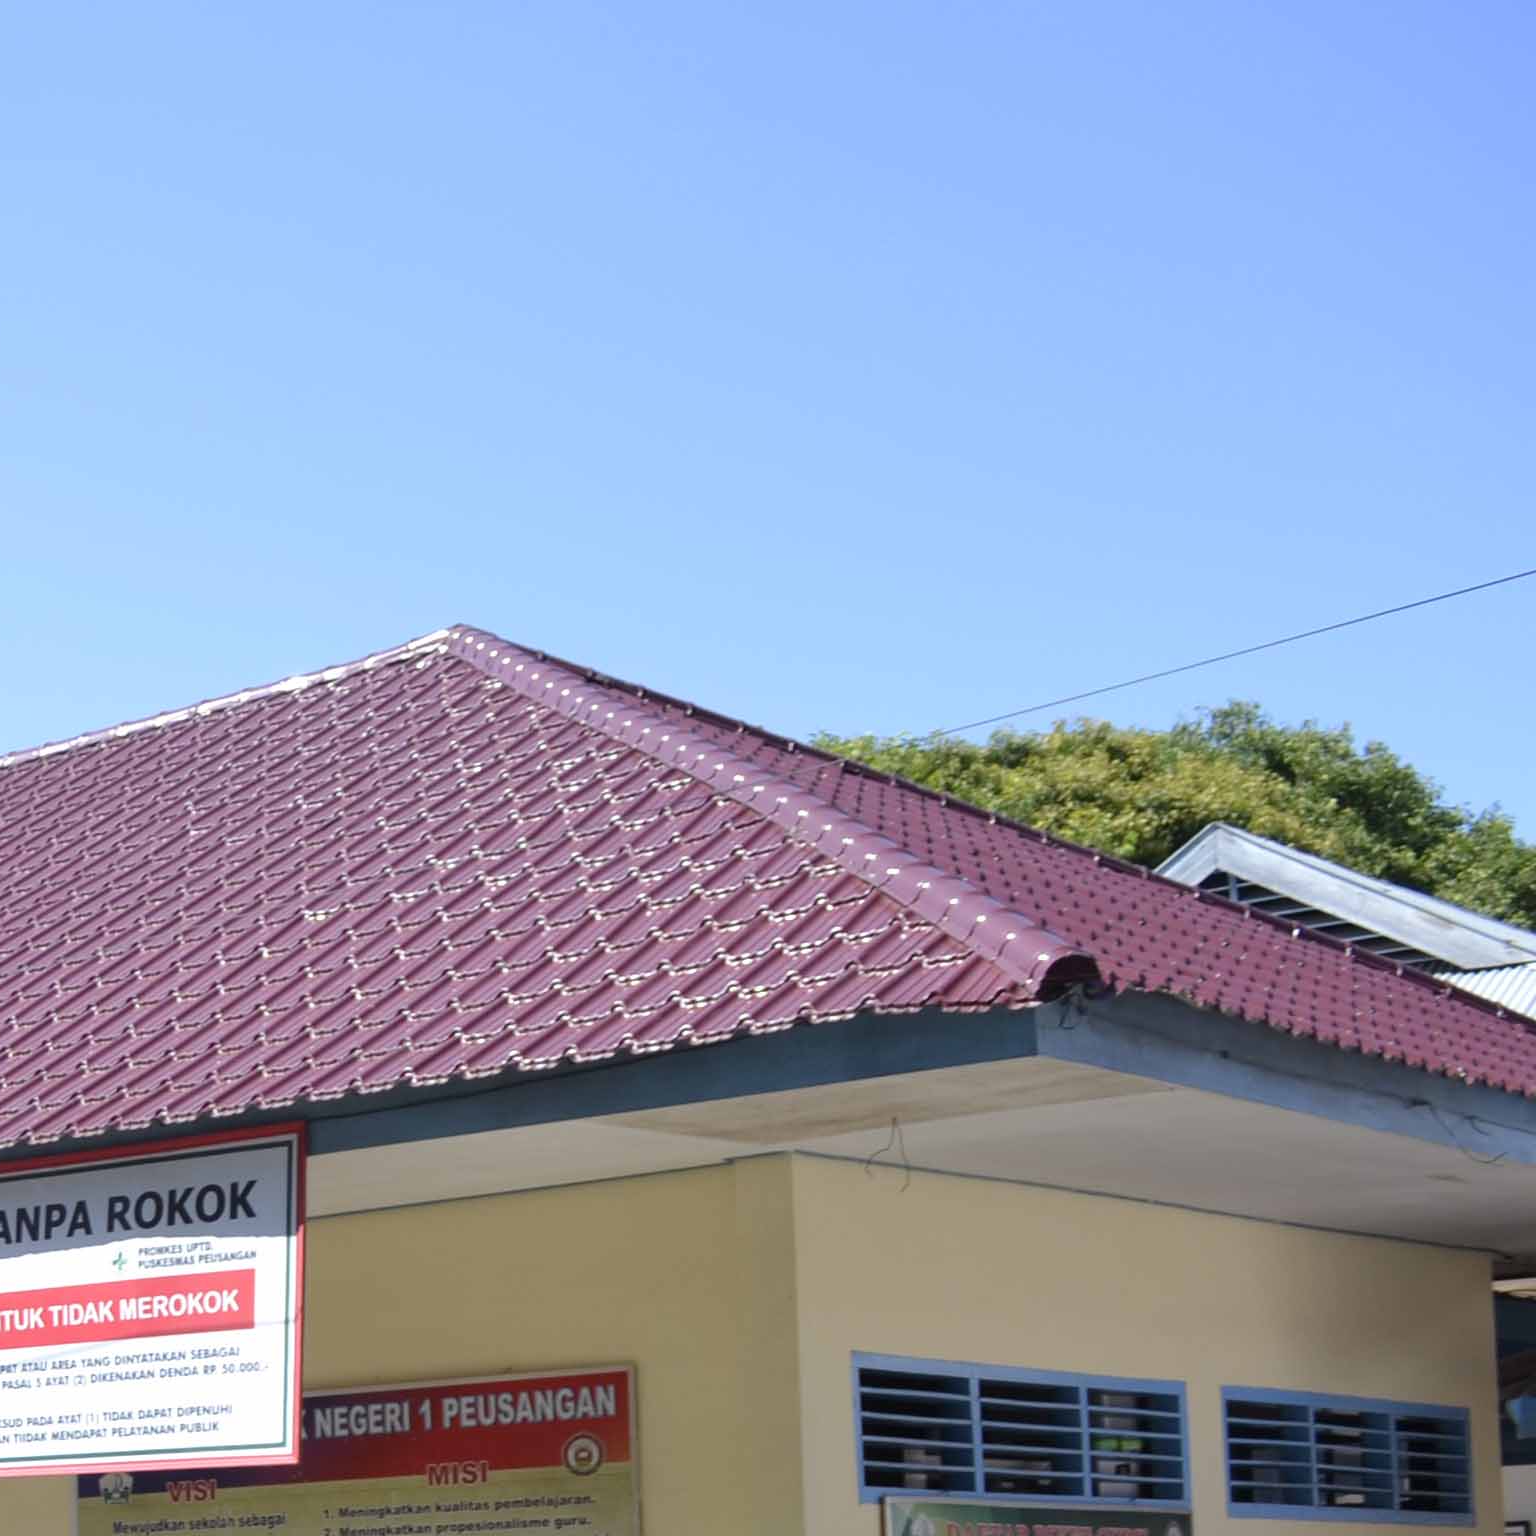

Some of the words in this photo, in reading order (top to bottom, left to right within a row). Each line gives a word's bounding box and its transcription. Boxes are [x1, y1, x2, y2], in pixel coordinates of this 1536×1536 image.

[107, 1180, 257, 1233] ROKOK
[198, 1250, 257, 1265] PEUSANGAN
[48, 1300, 115, 1328] TIDAK
[119, 1289, 240, 1322] MEROKOK
[20, 1360, 48, 1373] ATAU
[51, 1359, 77, 1370] AREA
[81, 1356, 111, 1368] YANG
[114, 1351, 187, 1365] DINYATAKAN
[190, 1346, 240, 1360] SEBAGAI
[1, 1379, 32, 1390] PASAL
[45, 1375, 70, 1386] AYAT
[90, 1369, 155, 1384] DIKENAKAN
[159, 1367, 199, 1379] DENDA
[26, 1416, 54, 1427] PADA
[57, 1413, 82, 1425] AYAT
[103, 1410, 134, 1422] TIDAK
[138, 1408, 173, 1420] DAPAT
[177, 1404, 233, 1417] DIPENUHI
[314, 1402, 410, 1439] NEGERI
[418, 1399, 433, 1430] 1
[442, 1385, 616, 1429] PEUSANGAN
[51, 1428, 108, 1441] MENDAPAT
[111, 1425, 176, 1438] PELAYANAN
[180, 1421, 220, 1433] PUBLIK
[427, 1460, 490, 1487] MISI
[165, 1479, 218, 1504] VISI
[338, 1504, 431, 1520] Meningkatkan
[435, 1500, 490, 1513] kualitas
[112, 1518, 186, 1536] Mewujudkan
[189, 1514, 235, 1531] sekolah
[238, 1512, 288, 1530] sebagai
[554, 1516, 592, 1530] guru.
